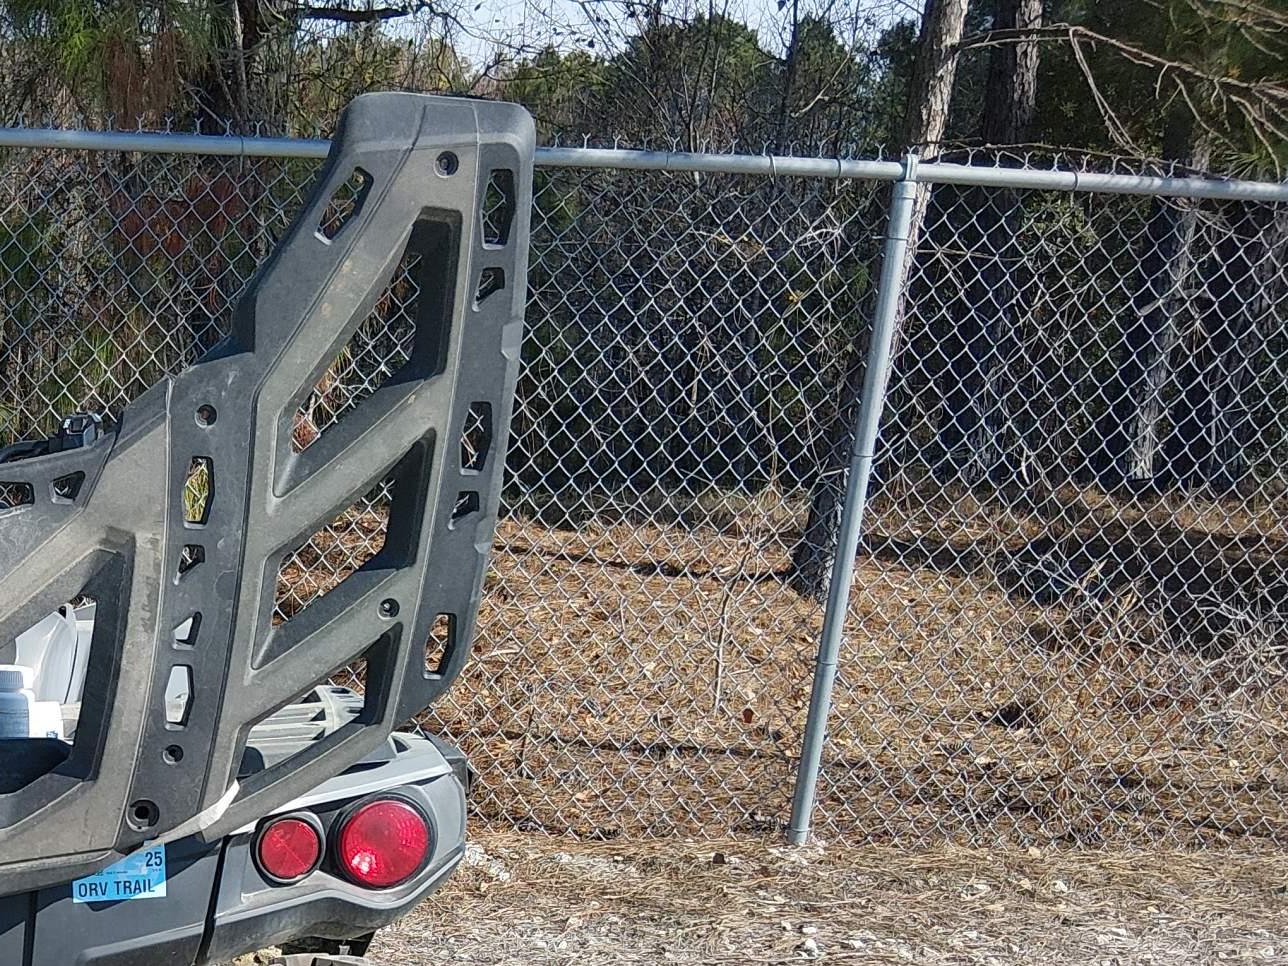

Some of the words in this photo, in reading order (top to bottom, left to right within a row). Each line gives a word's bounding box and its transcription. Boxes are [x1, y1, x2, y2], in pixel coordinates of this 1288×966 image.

[145, 851, 162, 867] 25
[78, 882, 108, 898] ORV
[114, 879, 155, 895] TRAIL
